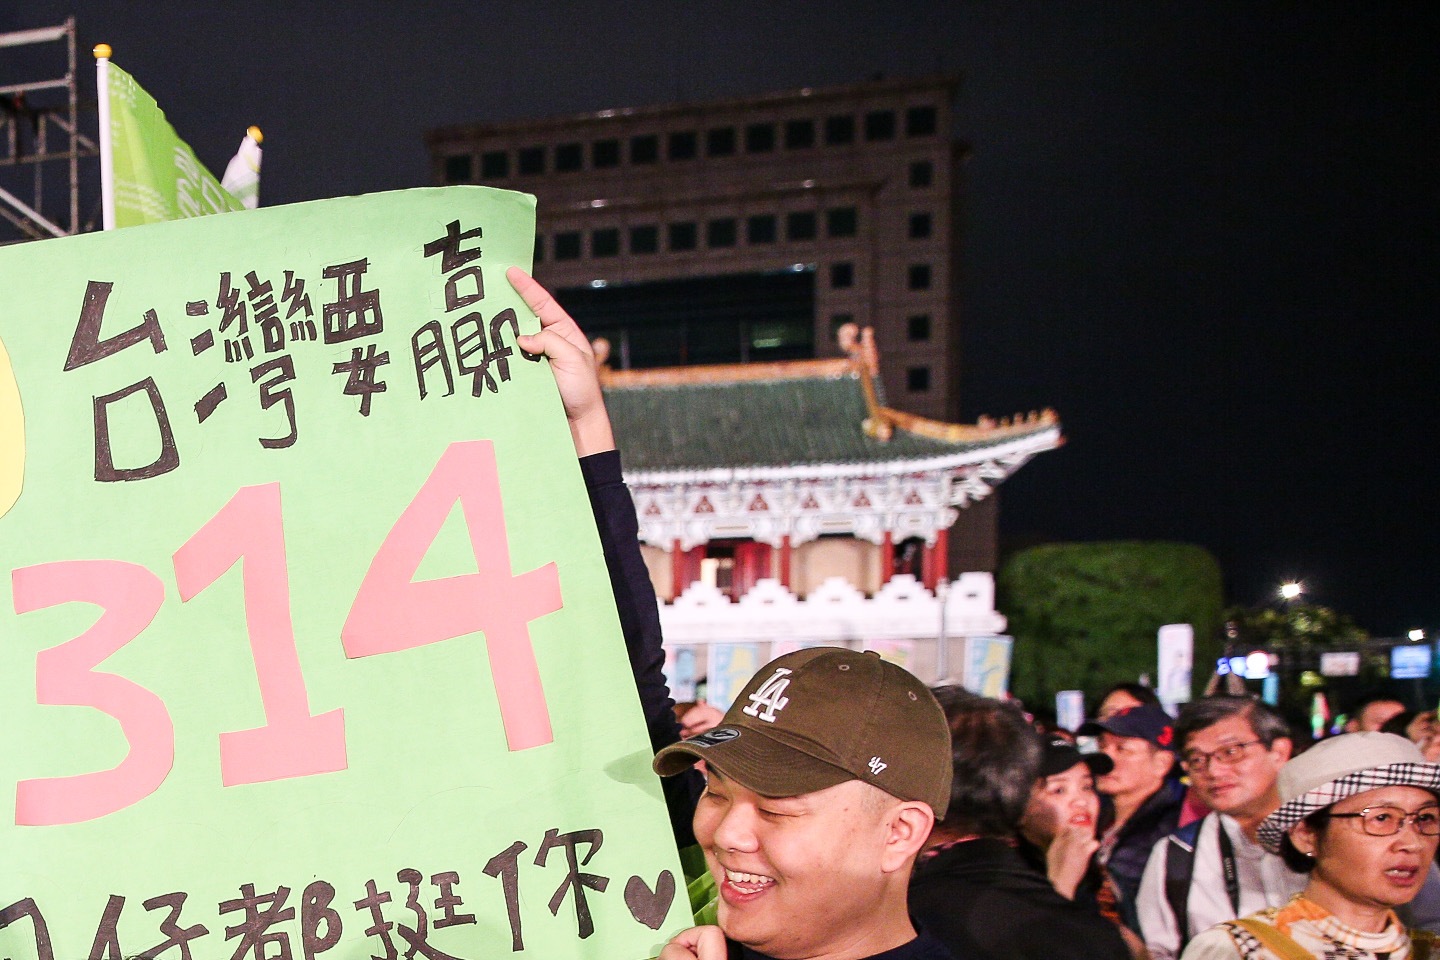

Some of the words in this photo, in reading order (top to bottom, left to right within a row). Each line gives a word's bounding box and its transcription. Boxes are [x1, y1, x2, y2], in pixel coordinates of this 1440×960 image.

[63, 219, 542, 483] 台灣要贏
[742, 667, 793, 723] LA
